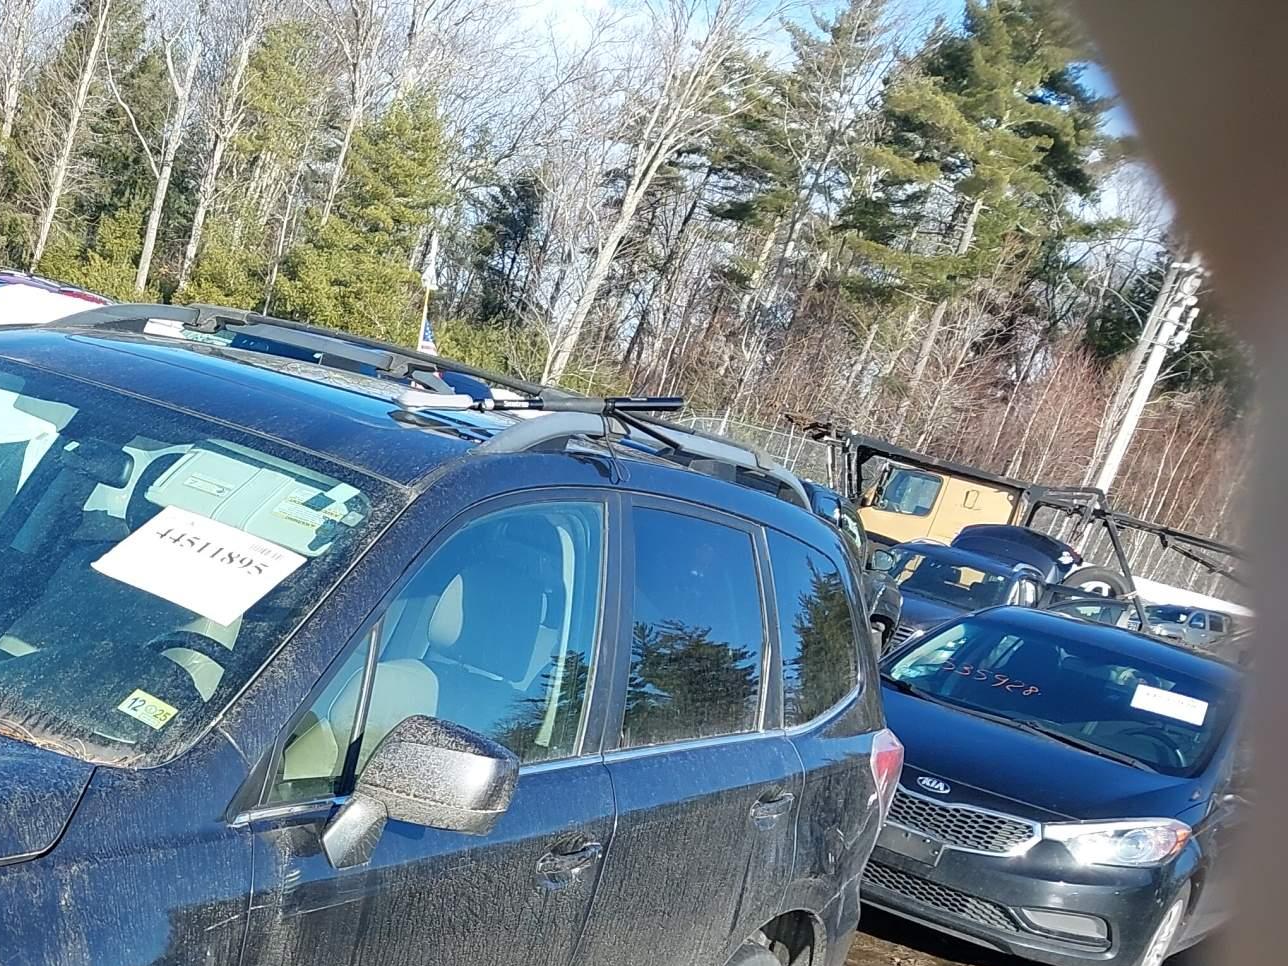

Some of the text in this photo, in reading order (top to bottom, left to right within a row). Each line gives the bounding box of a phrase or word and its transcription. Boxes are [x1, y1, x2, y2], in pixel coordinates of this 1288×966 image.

[155, 528, 269, 574] 44511895
[128, 697, 172, 722] 12 25
[920, 776, 946, 792] KIA
